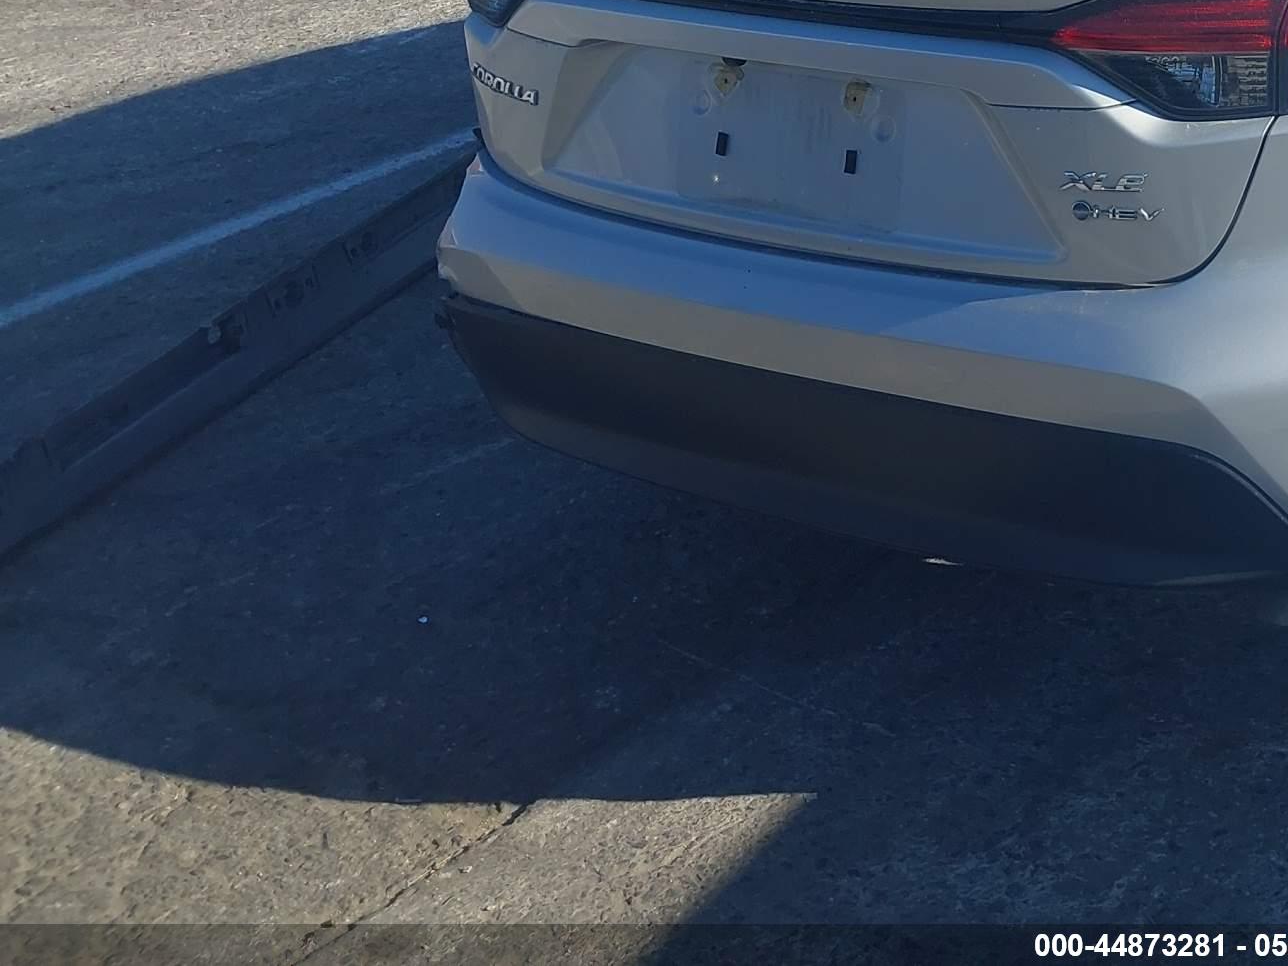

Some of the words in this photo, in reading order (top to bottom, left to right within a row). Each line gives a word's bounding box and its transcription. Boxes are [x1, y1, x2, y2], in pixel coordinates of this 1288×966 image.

[471, 61, 539, 106] COROLLA
[1060, 171, 1149, 193] XLE
[1092, 206, 1166, 222] HEV
